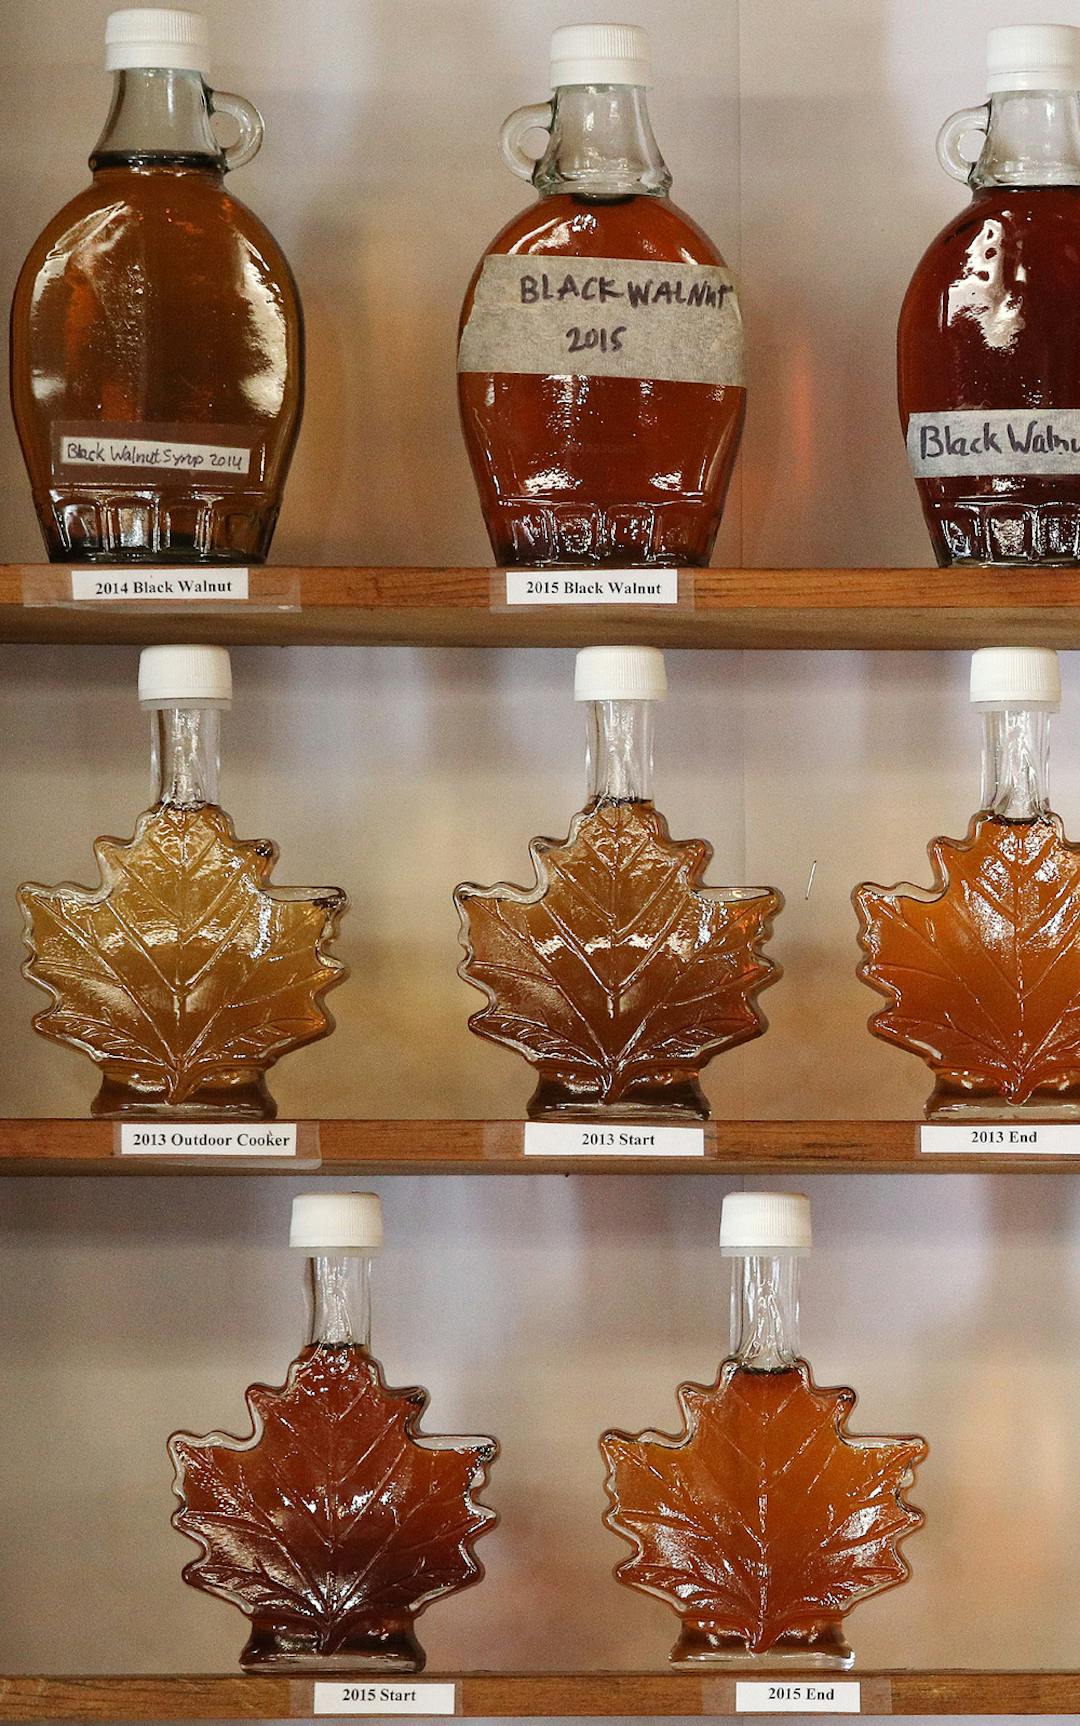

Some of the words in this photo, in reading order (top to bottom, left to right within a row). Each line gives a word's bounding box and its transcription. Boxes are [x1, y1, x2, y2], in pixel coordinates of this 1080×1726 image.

[520, 274, 624, 304] BLACK
[566, 326, 627, 353] 2015
[919, 421, 1003, 460] Black
[67, 442, 105, 461] Black
[110, 445, 160, 465] Walnut
[163, 448, 204, 468] Syrup
[209, 453, 243, 471] 2014
[95, 582, 128, 595] 2014
[133, 581, 174, 594] Black
[178, 580, 232, 593] Walnut
[526, 581, 559, 594] 2015
[564, 582, 603, 594] Black
[608, 582, 661, 594] Walnut
[133, 1133, 166, 1146] 2013
[171, 1133, 232, 1146] Outdoor
[237, 1131, 290, 1147] Cooker
[582, 1133, 614, 1146] 2013
[619, 1133, 655, 1146] Start
[971, 1131, 1004, 1143] 2013
[1009, 1131, 1038, 1143] End
[342, 1688, 376, 1701] 2015
[380, 1688, 416, 1701] Start
[768, 1688, 801, 1700] 2015
[806, 1688, 834, 1700] End
